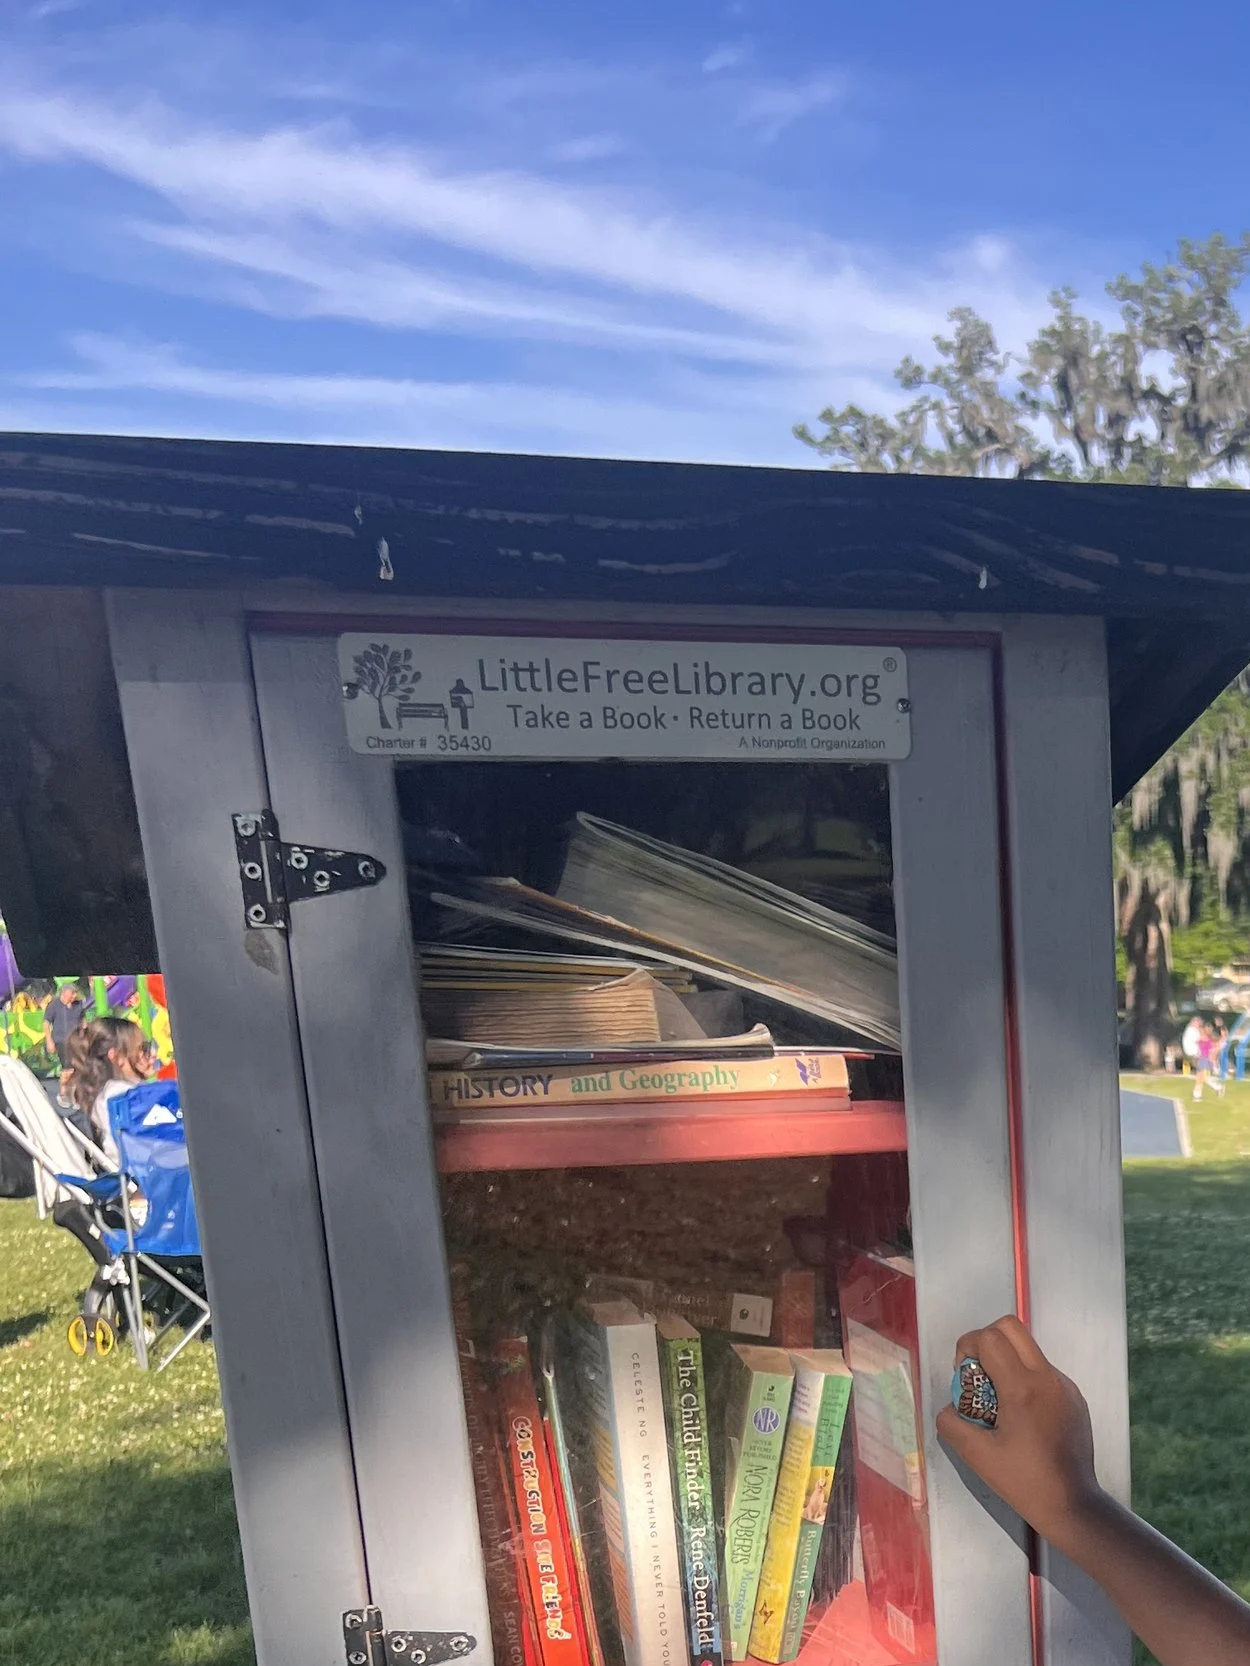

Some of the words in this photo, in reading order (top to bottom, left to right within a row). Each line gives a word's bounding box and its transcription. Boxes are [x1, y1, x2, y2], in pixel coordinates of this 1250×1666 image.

[507, 703, 570, 730] Take
[579, 711, 594, 730] a
[690, 706, 772, 731] Return
[779, 712, 794, 731] a
[802, 707, 862, 731] Book
[365, 735, 417, 751] Charter
[418, 736, 428, 749] #
[437, 734, 492, 752] 35430
[738, 736, 749, 750] A
[751, 736, 806, 751] Nonprofit
[810, 737, 887, 753] Organization
[444, 1073, 554, 1100] HISTORY
[571, 1070, 612, 1094] and
[618, 1064, 741, 1093] Geography
[677, 1350, 698, 1388] The
[631, 1352, 645, 1413] CELESTE
[639, 1420, 648, 1438] NG
[680, 1393, 701, 1444] Child
[512, 1416, 548, 1536] CONSTRUCTION
[641, 1454, 658, 1538] EVERYTHING
[683, 1449, 705, 1511] Finder
[740, 1463, 768, 1502] NORA
[534, 1539, 554, 1573] SITE
[690, 1526, 707, 1570] Rene
[730, 1508, 761, 1565] ROBERTS
[653, 1554, 664, 1598] NEVER
[503, 1611, 519, 1642] SEAN
[540, 1574, 572, 1640] FRIENDS
[657, 1604, 668, 1637] TOLD
[693, 1575, 716, 1646] Denfeld
[662, 1644, 671, 1666] YOU
